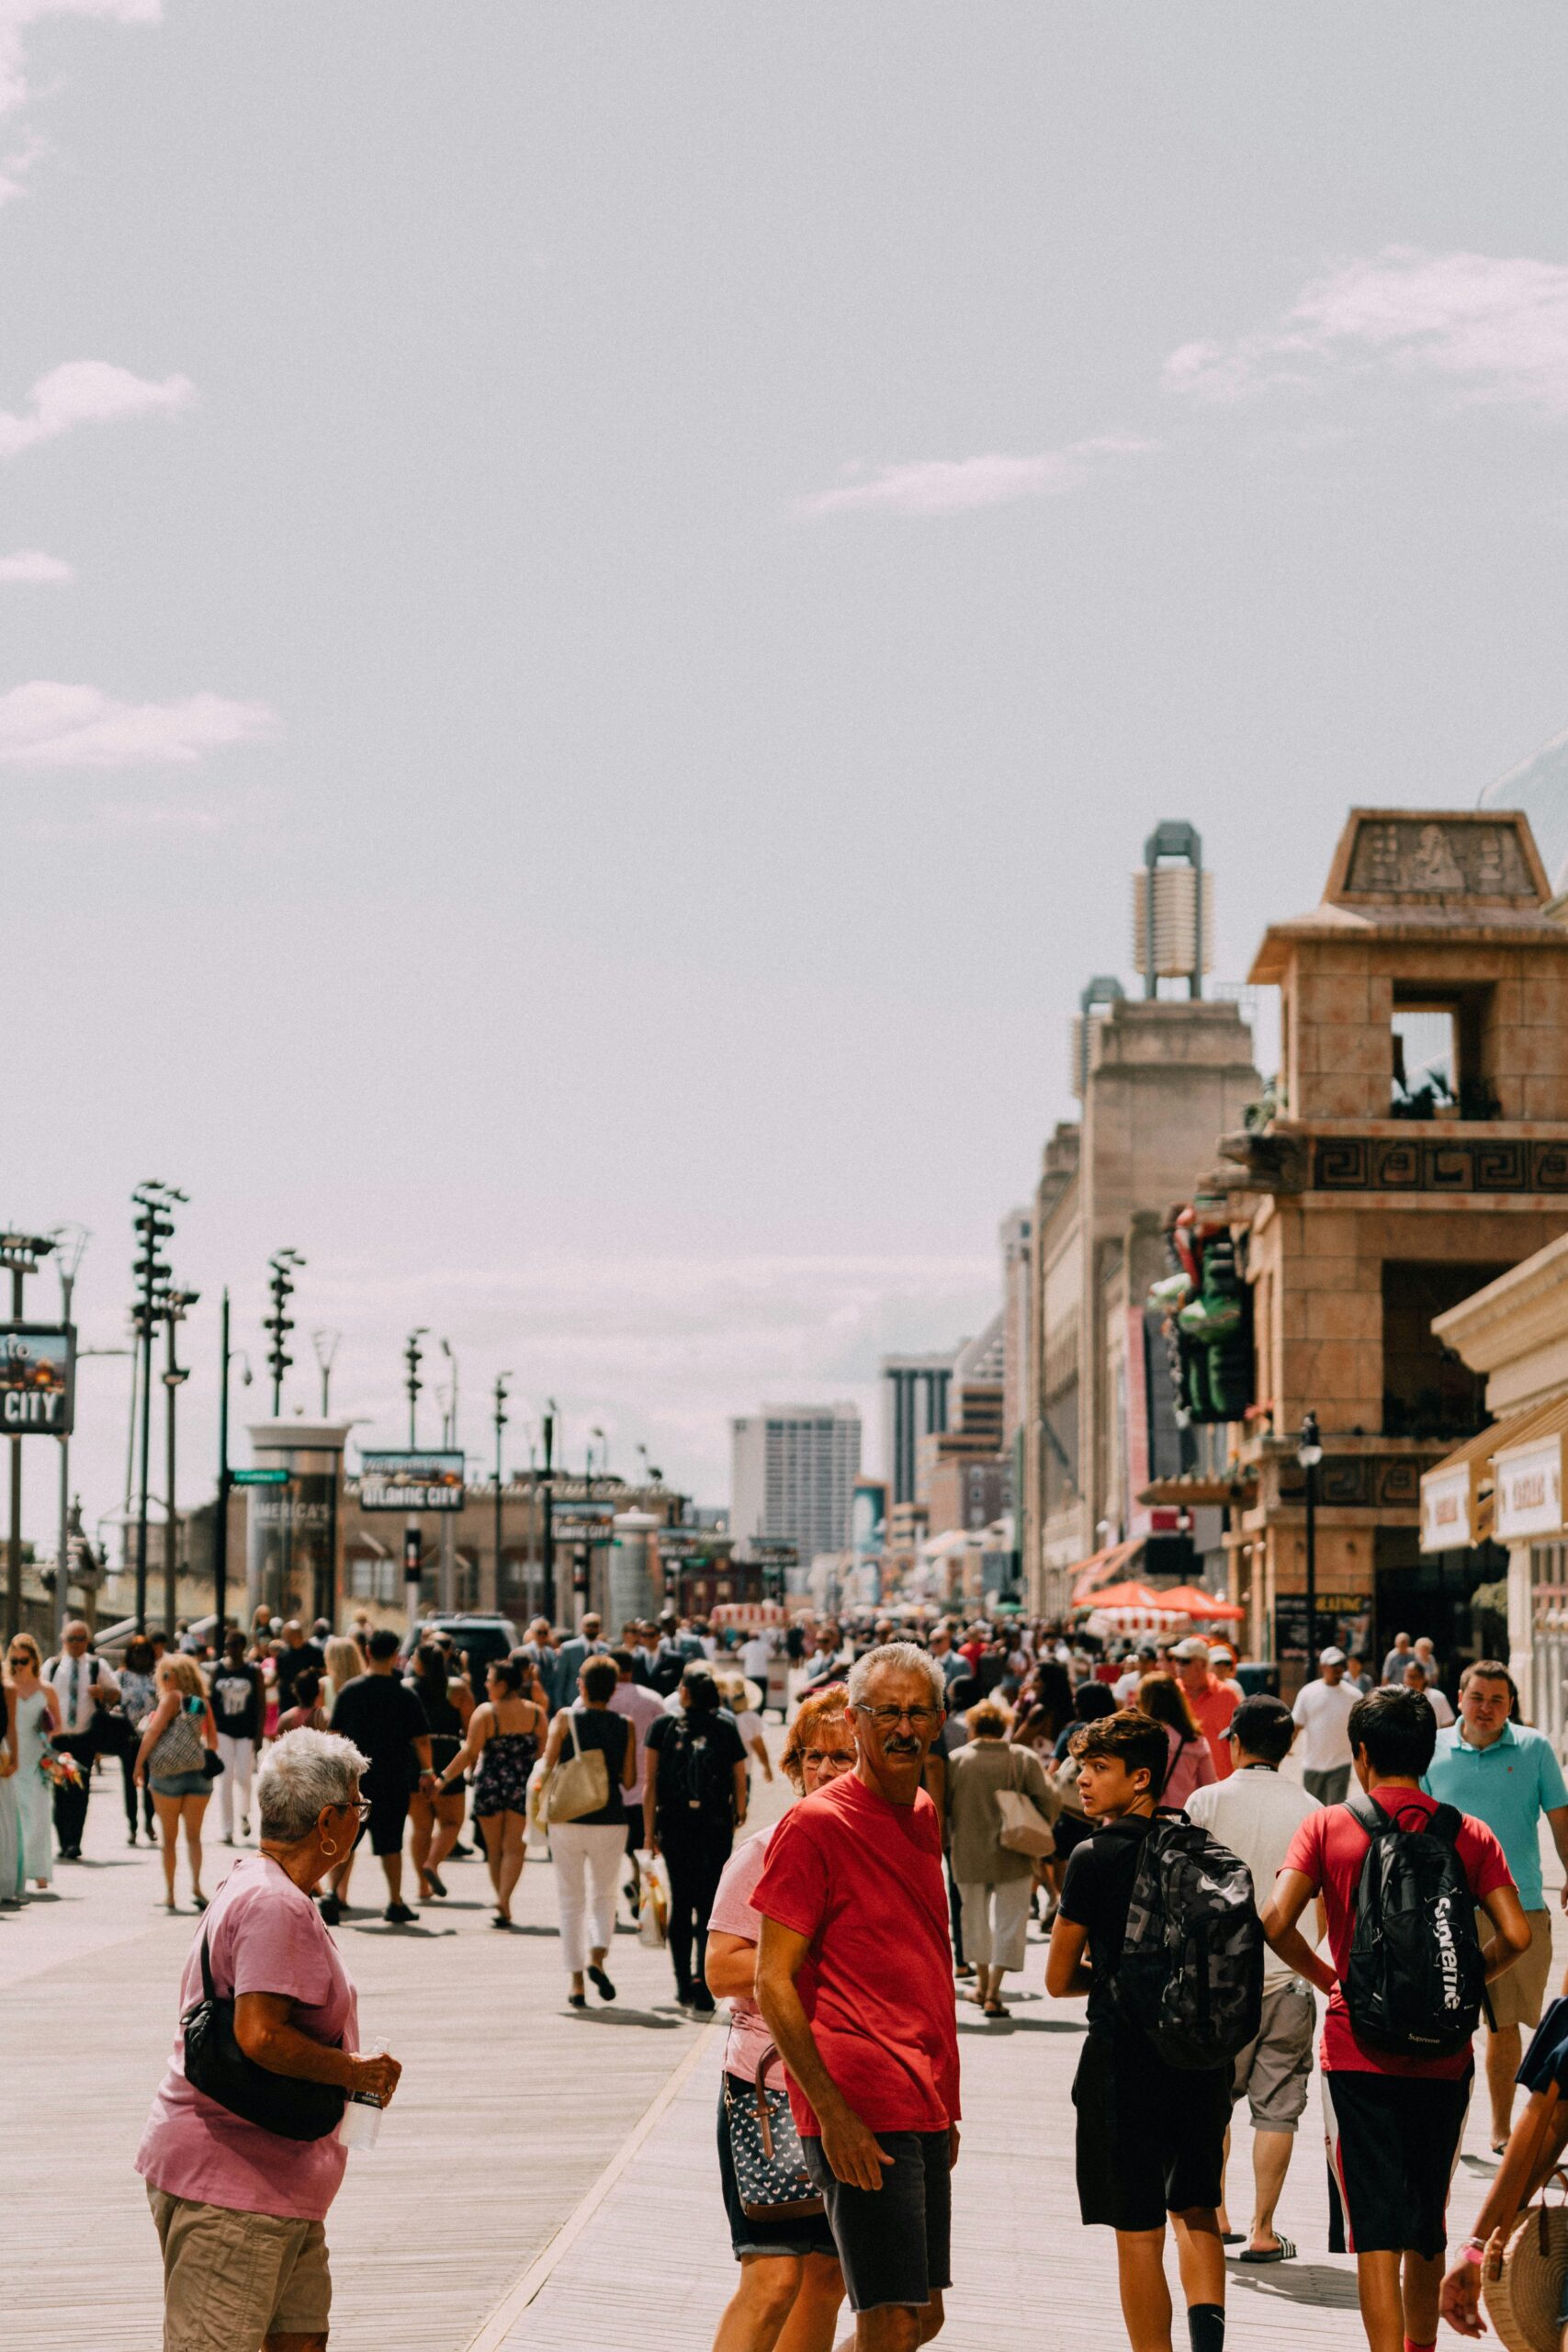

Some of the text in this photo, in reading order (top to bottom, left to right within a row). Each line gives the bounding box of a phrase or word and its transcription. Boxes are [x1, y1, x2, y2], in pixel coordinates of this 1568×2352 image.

[5, 1391, 57, 1423] CITY
[427, 1487, 459, 1507] CITY
[1408, 2032, 1440, 2045] Supreme
